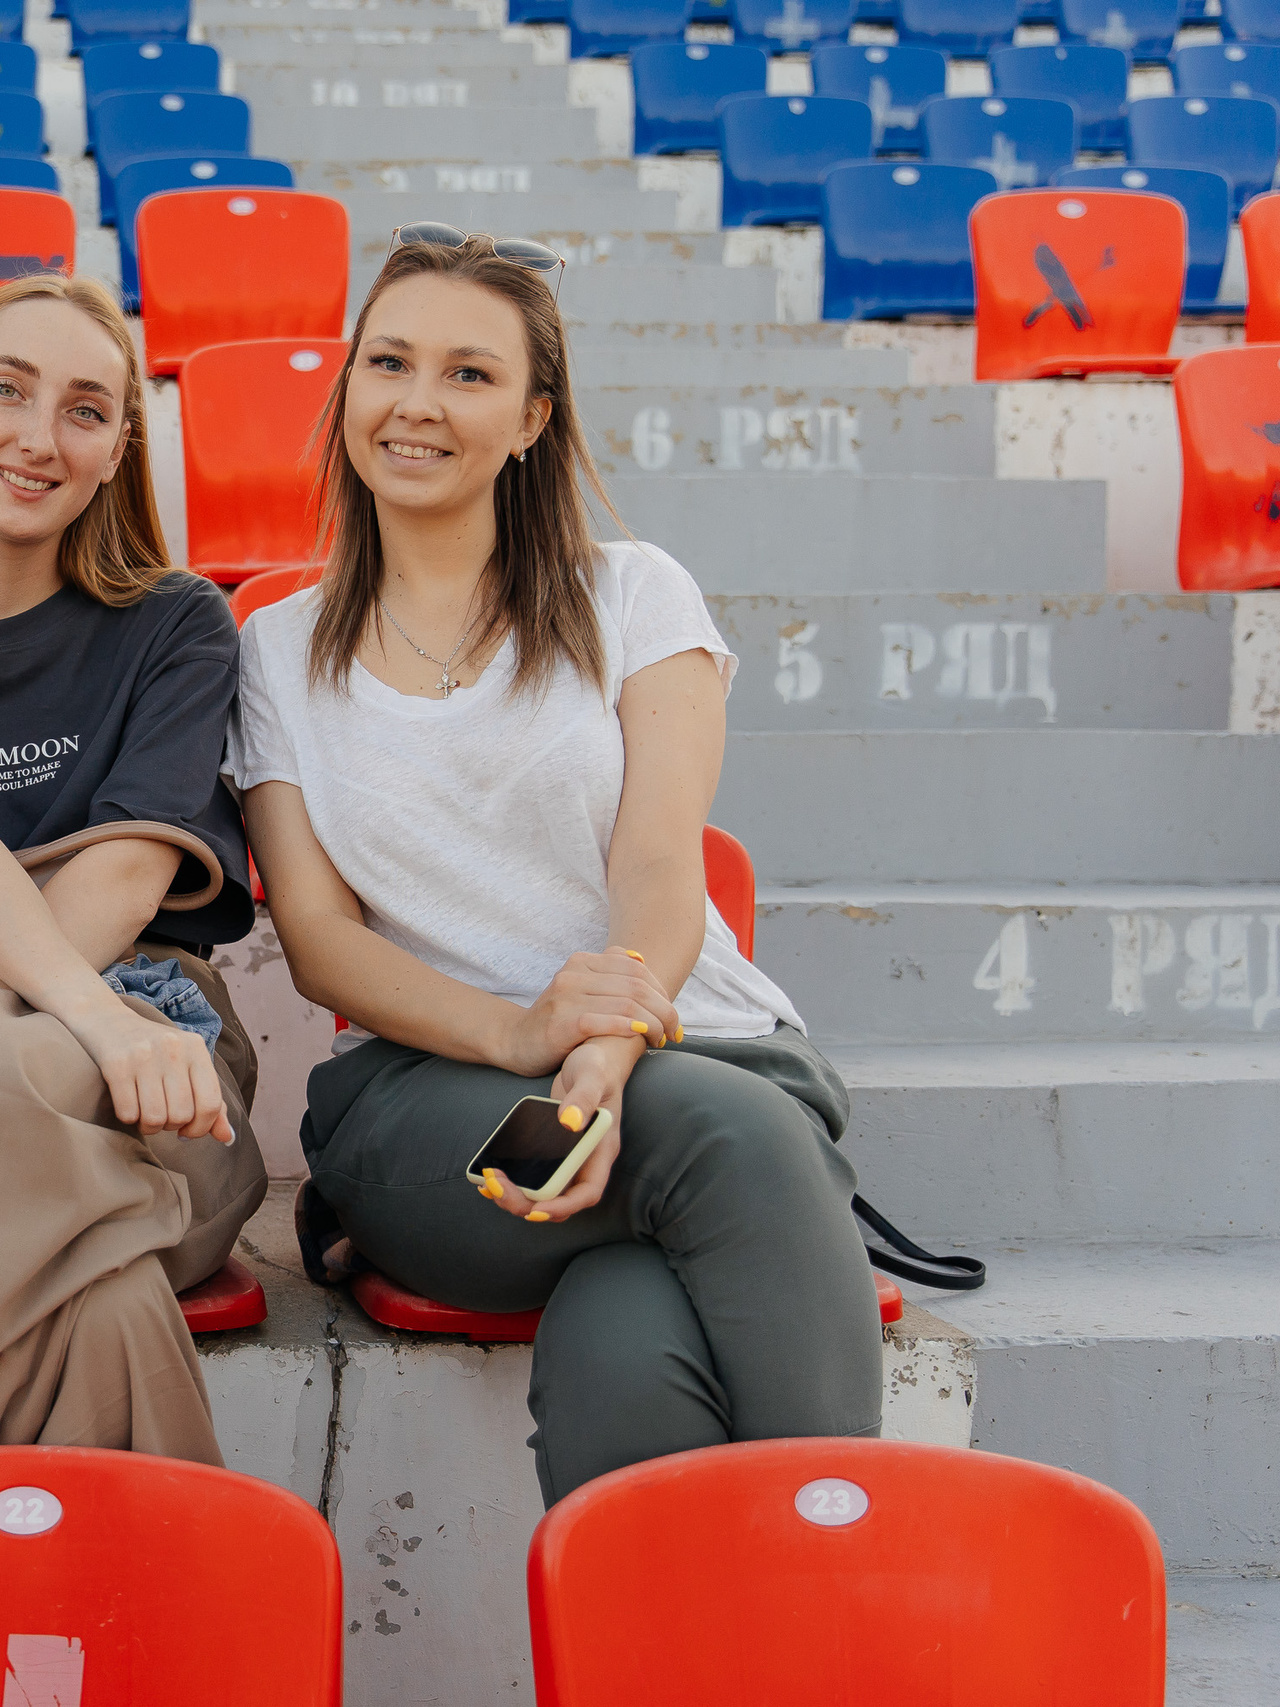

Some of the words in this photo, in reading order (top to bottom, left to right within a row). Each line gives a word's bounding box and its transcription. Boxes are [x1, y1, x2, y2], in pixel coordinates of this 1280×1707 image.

[632, 406, 674, 471] 6
[720, 405, 861, 475] РЯД
[774, 622, 822, 705] 5
[878, 621, 1058, 724] РЯД
[15, 768, 31, 778] TO
[31, 760, 62, 776] MAKE
[25, 771, 58, 787] HAPPY
[973, 911, 1036, 1016] 4
[5, 1497, 45, 1524] 22
[811, 1489, 851, 1515] 23
